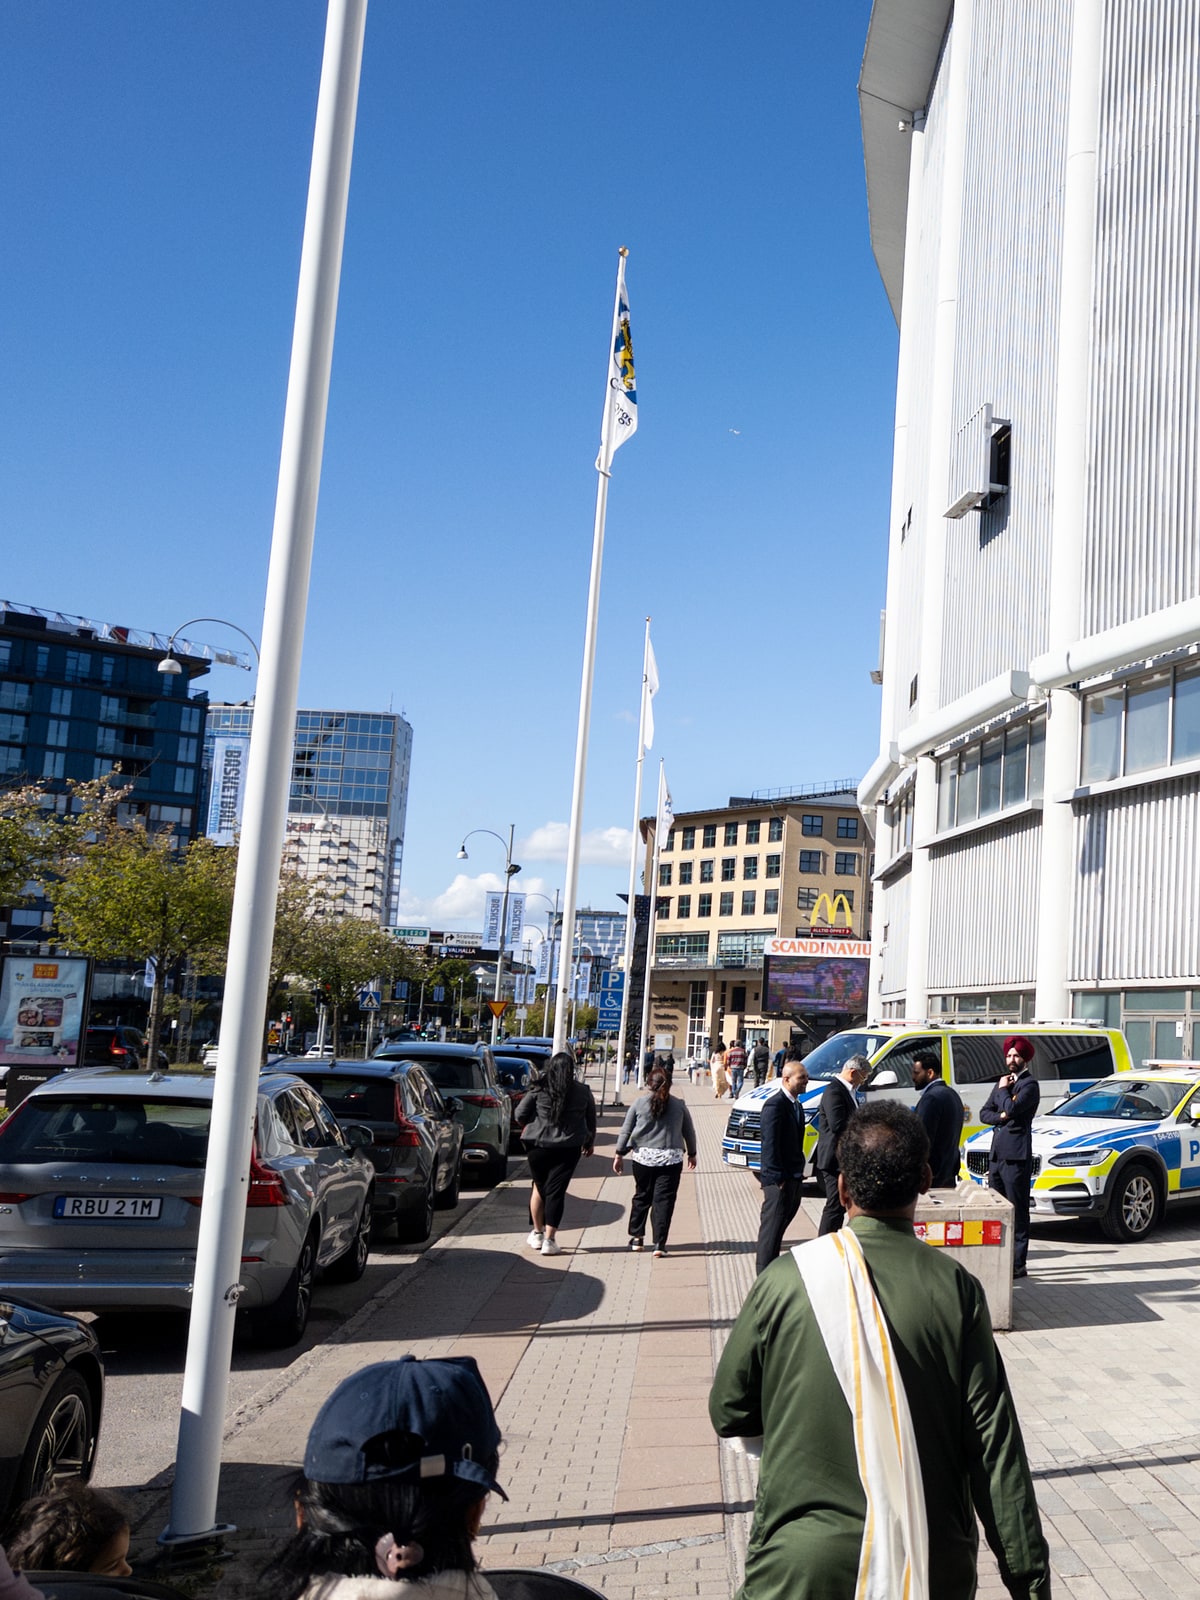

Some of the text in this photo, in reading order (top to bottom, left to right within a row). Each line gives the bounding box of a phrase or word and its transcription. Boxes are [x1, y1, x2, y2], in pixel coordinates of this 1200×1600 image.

[218, 749, 242, 833] BASKETBALL
[488, 898, 500, 944] BASKETBALL
[510, 899, 523, 945] BASKETBALL
[771, 940, 871, 956] SCANDINAVIU
[608, 973, 620, 988] P
[743, 1087, 779, 1100] POL
[1031, 1127, 1068, 1137] LIS
[71, 1199, 153, 1216] RBU 21M
